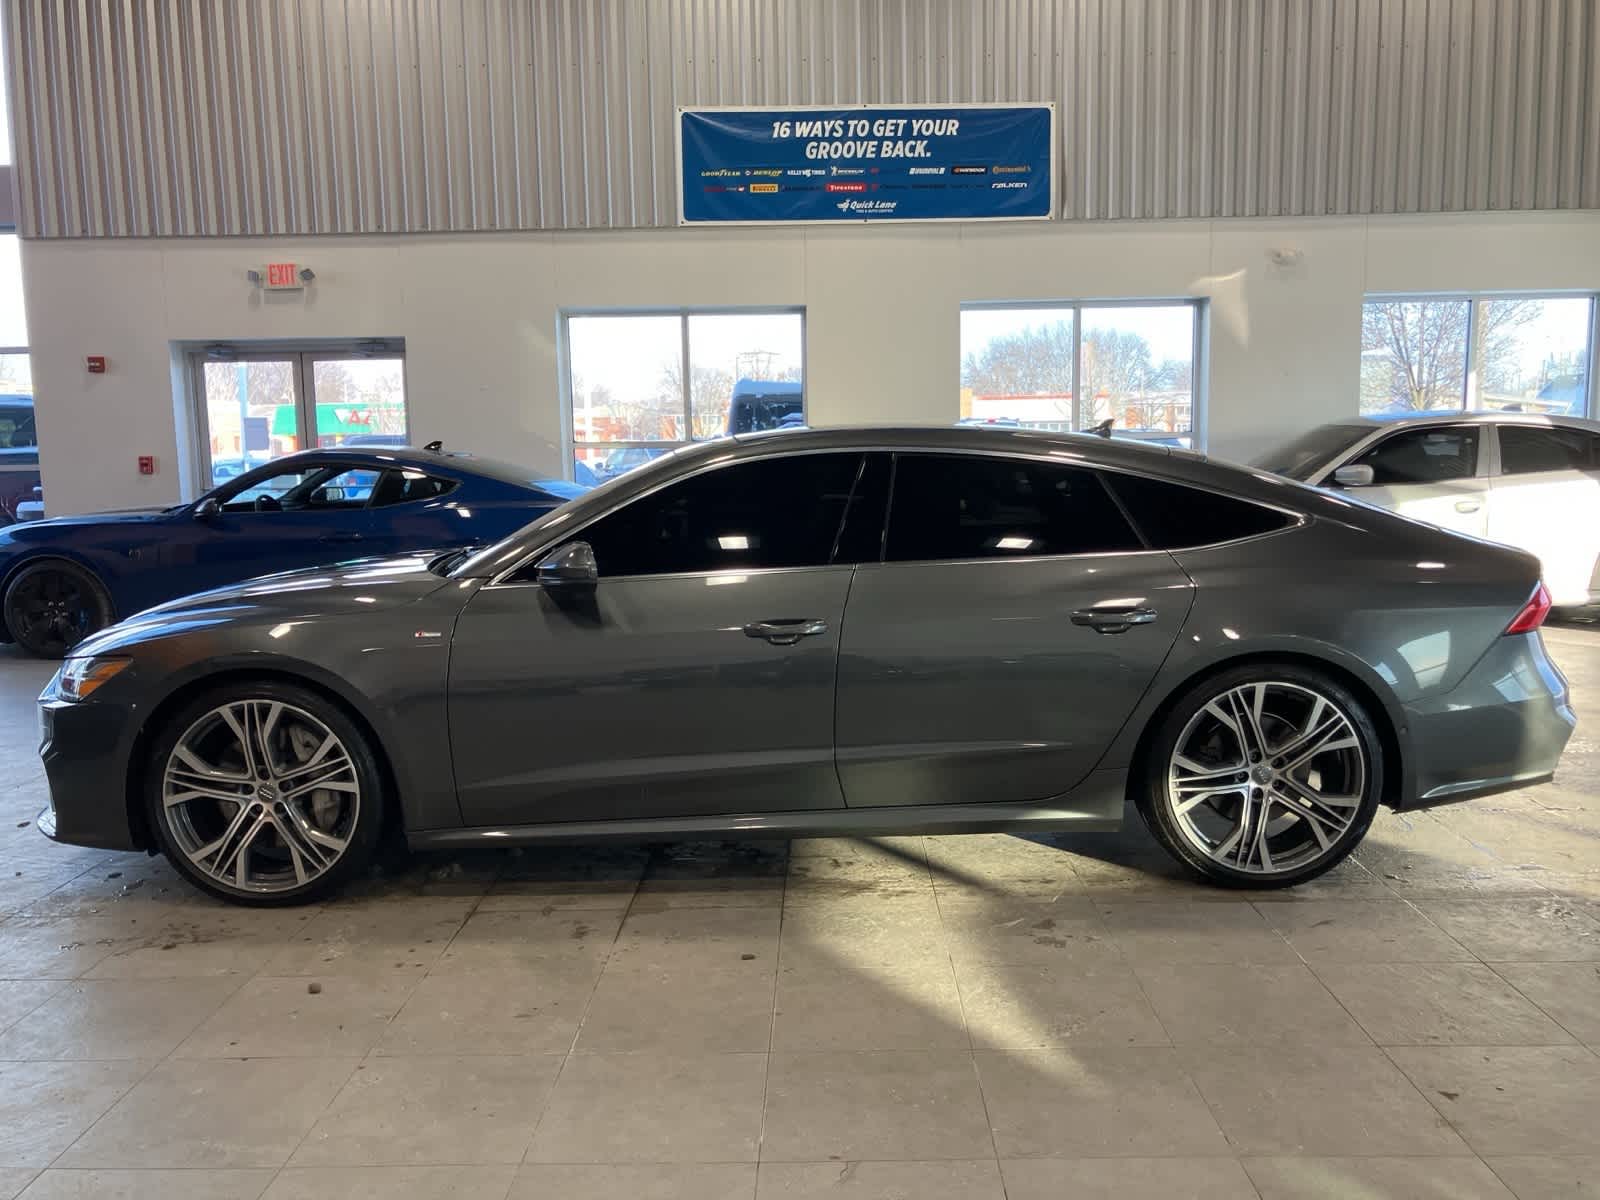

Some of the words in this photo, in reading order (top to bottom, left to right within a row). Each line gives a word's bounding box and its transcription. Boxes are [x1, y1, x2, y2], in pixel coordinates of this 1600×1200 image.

[772, 121, 791, 138] 16
[795, 120, 844, 138] WAYS
[847, 120, 870, 137] TO
[872, 119, 907, 137] GET
[911, 119, 960, 136] YOUR
[805, 140, 877, 159] GROOVE
[880, 140, 932, 158] BACK.
[701, 169, 741, 177] GOODYEAR
[850, 200, 875, 210] Quick
[874, 200, 897, 209] Lane
[268, 263, 297, 286] EXIT
